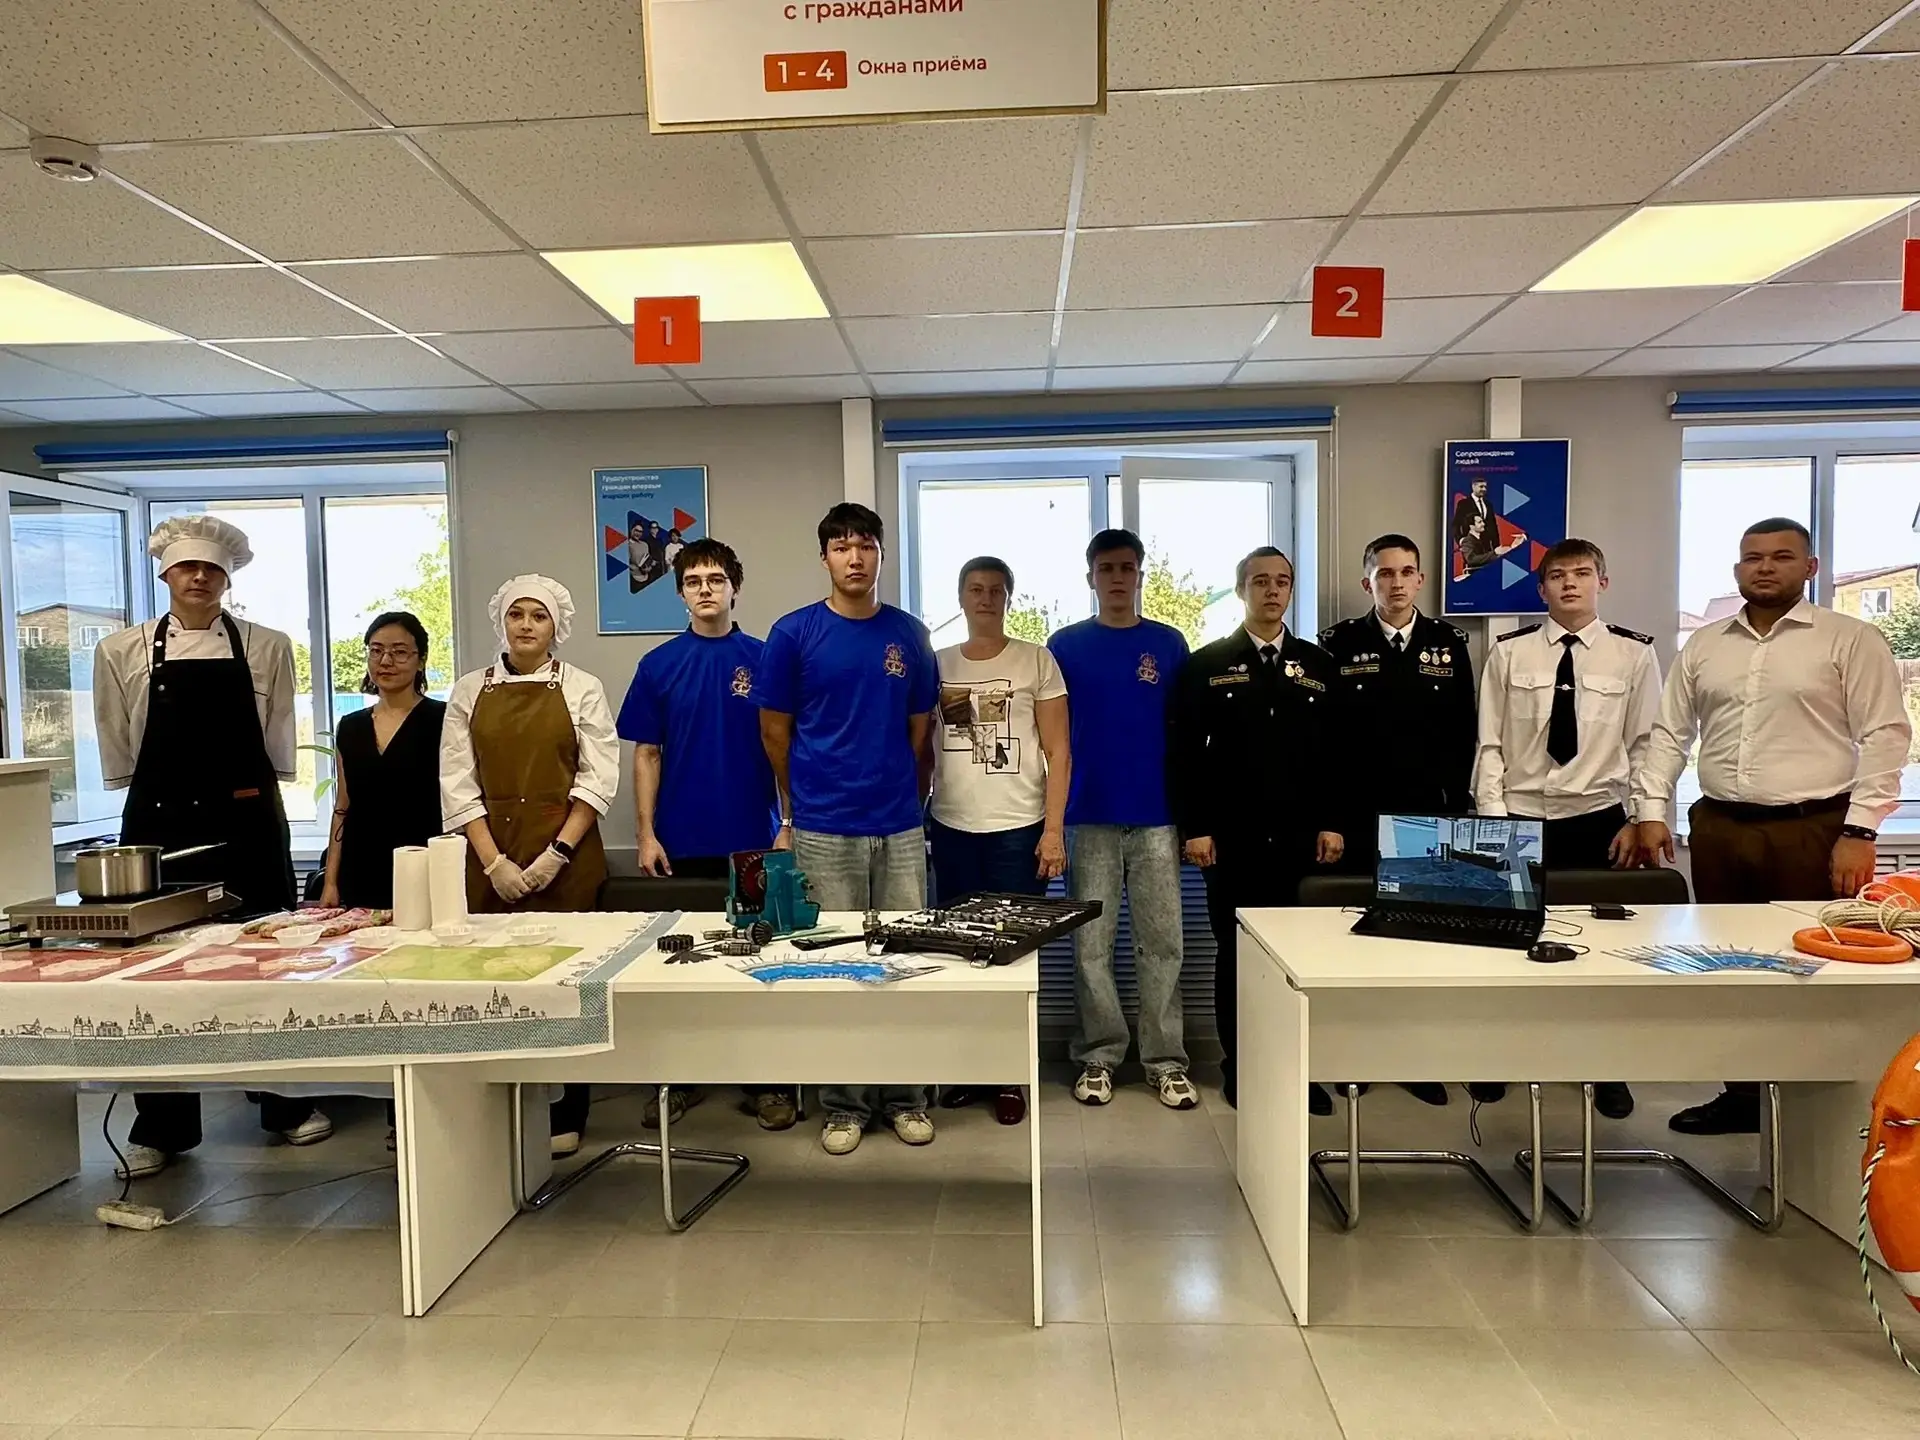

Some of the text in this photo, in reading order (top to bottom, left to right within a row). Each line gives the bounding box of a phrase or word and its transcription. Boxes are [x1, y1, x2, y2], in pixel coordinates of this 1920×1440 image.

[783, 0, 964, 23] с гражданами
[777, 61, 788, 84] 1
[815, 59, 835, 82] 4
[857, 55, 987, 76] Окна приёма
[1336, 286, 1359, 318] 2
[659, 316, 672, 346] 1
